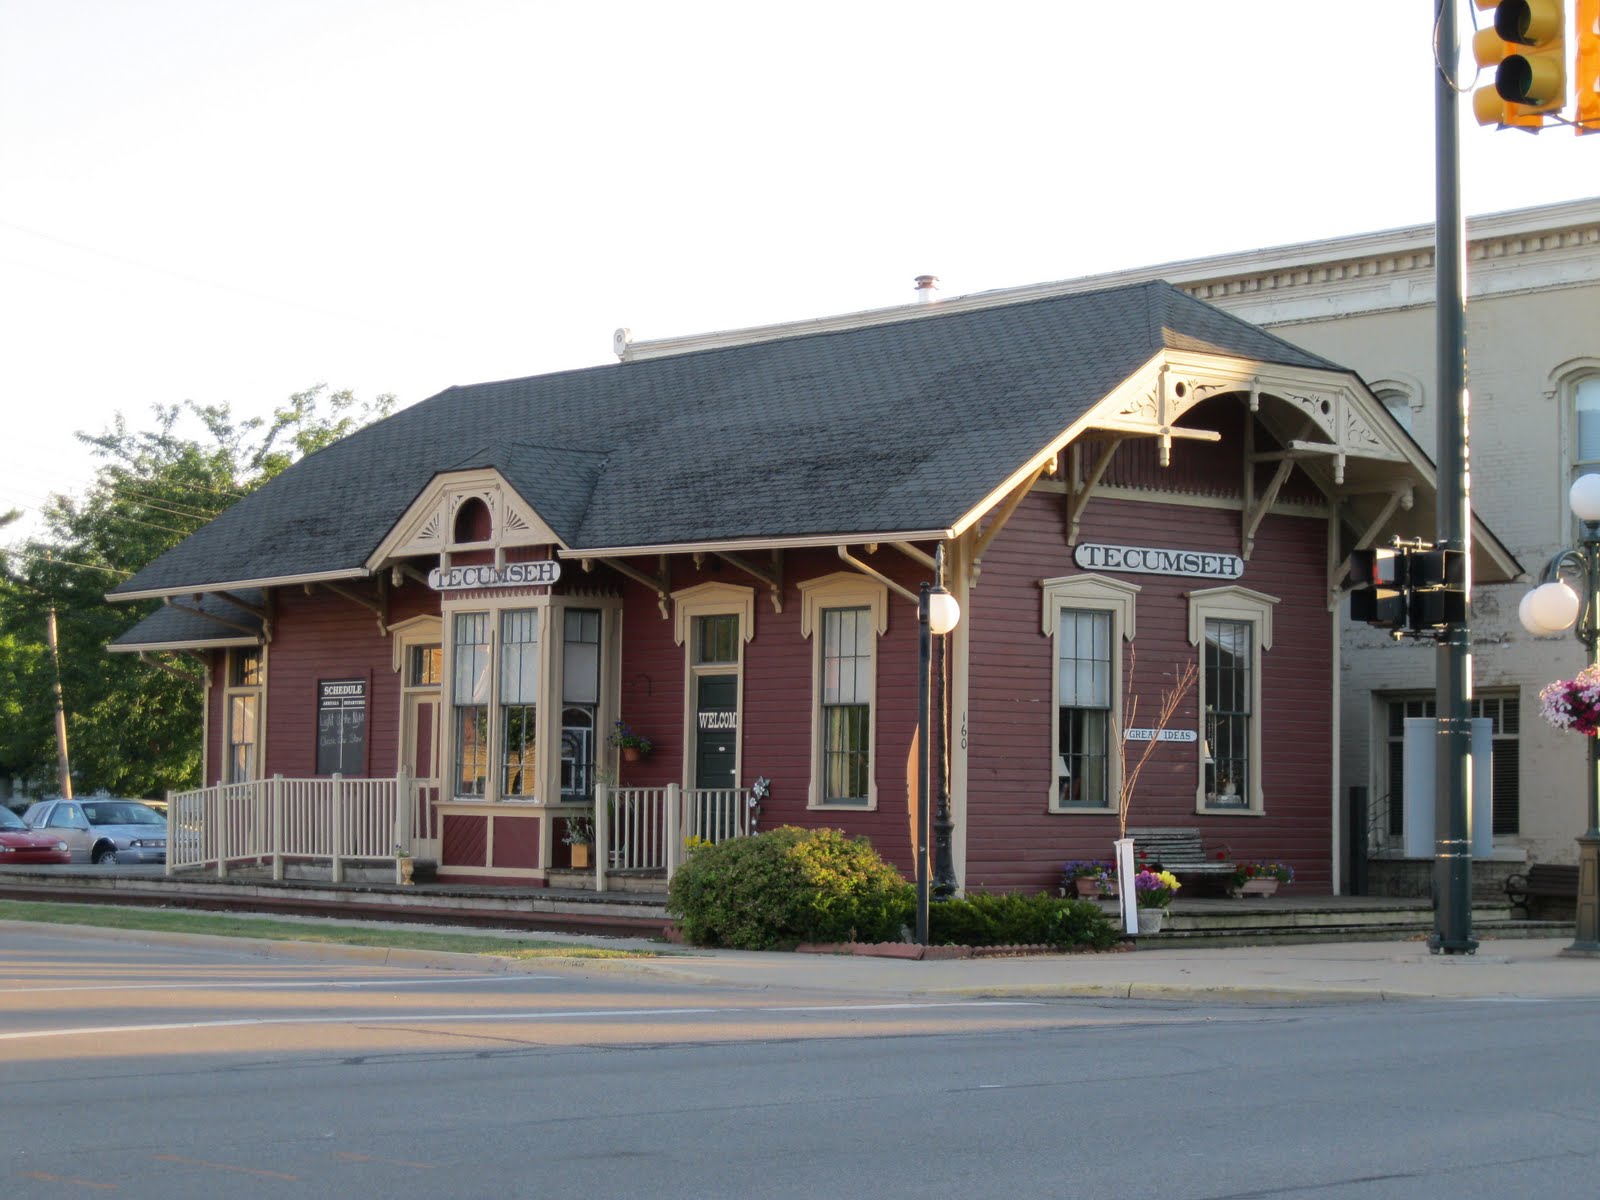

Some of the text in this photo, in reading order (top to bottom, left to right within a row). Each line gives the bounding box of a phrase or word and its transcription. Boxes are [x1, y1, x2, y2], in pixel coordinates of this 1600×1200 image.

[1084, 546, 1238, 575] TECUMSEH
[435, 563, 556, 588] TECUMSEH
[324, 685, 362, 695] SCHEDULE
[698, 711, 738, 729] WELCOM
[1164, 730, 1191, 740] IDEAS
